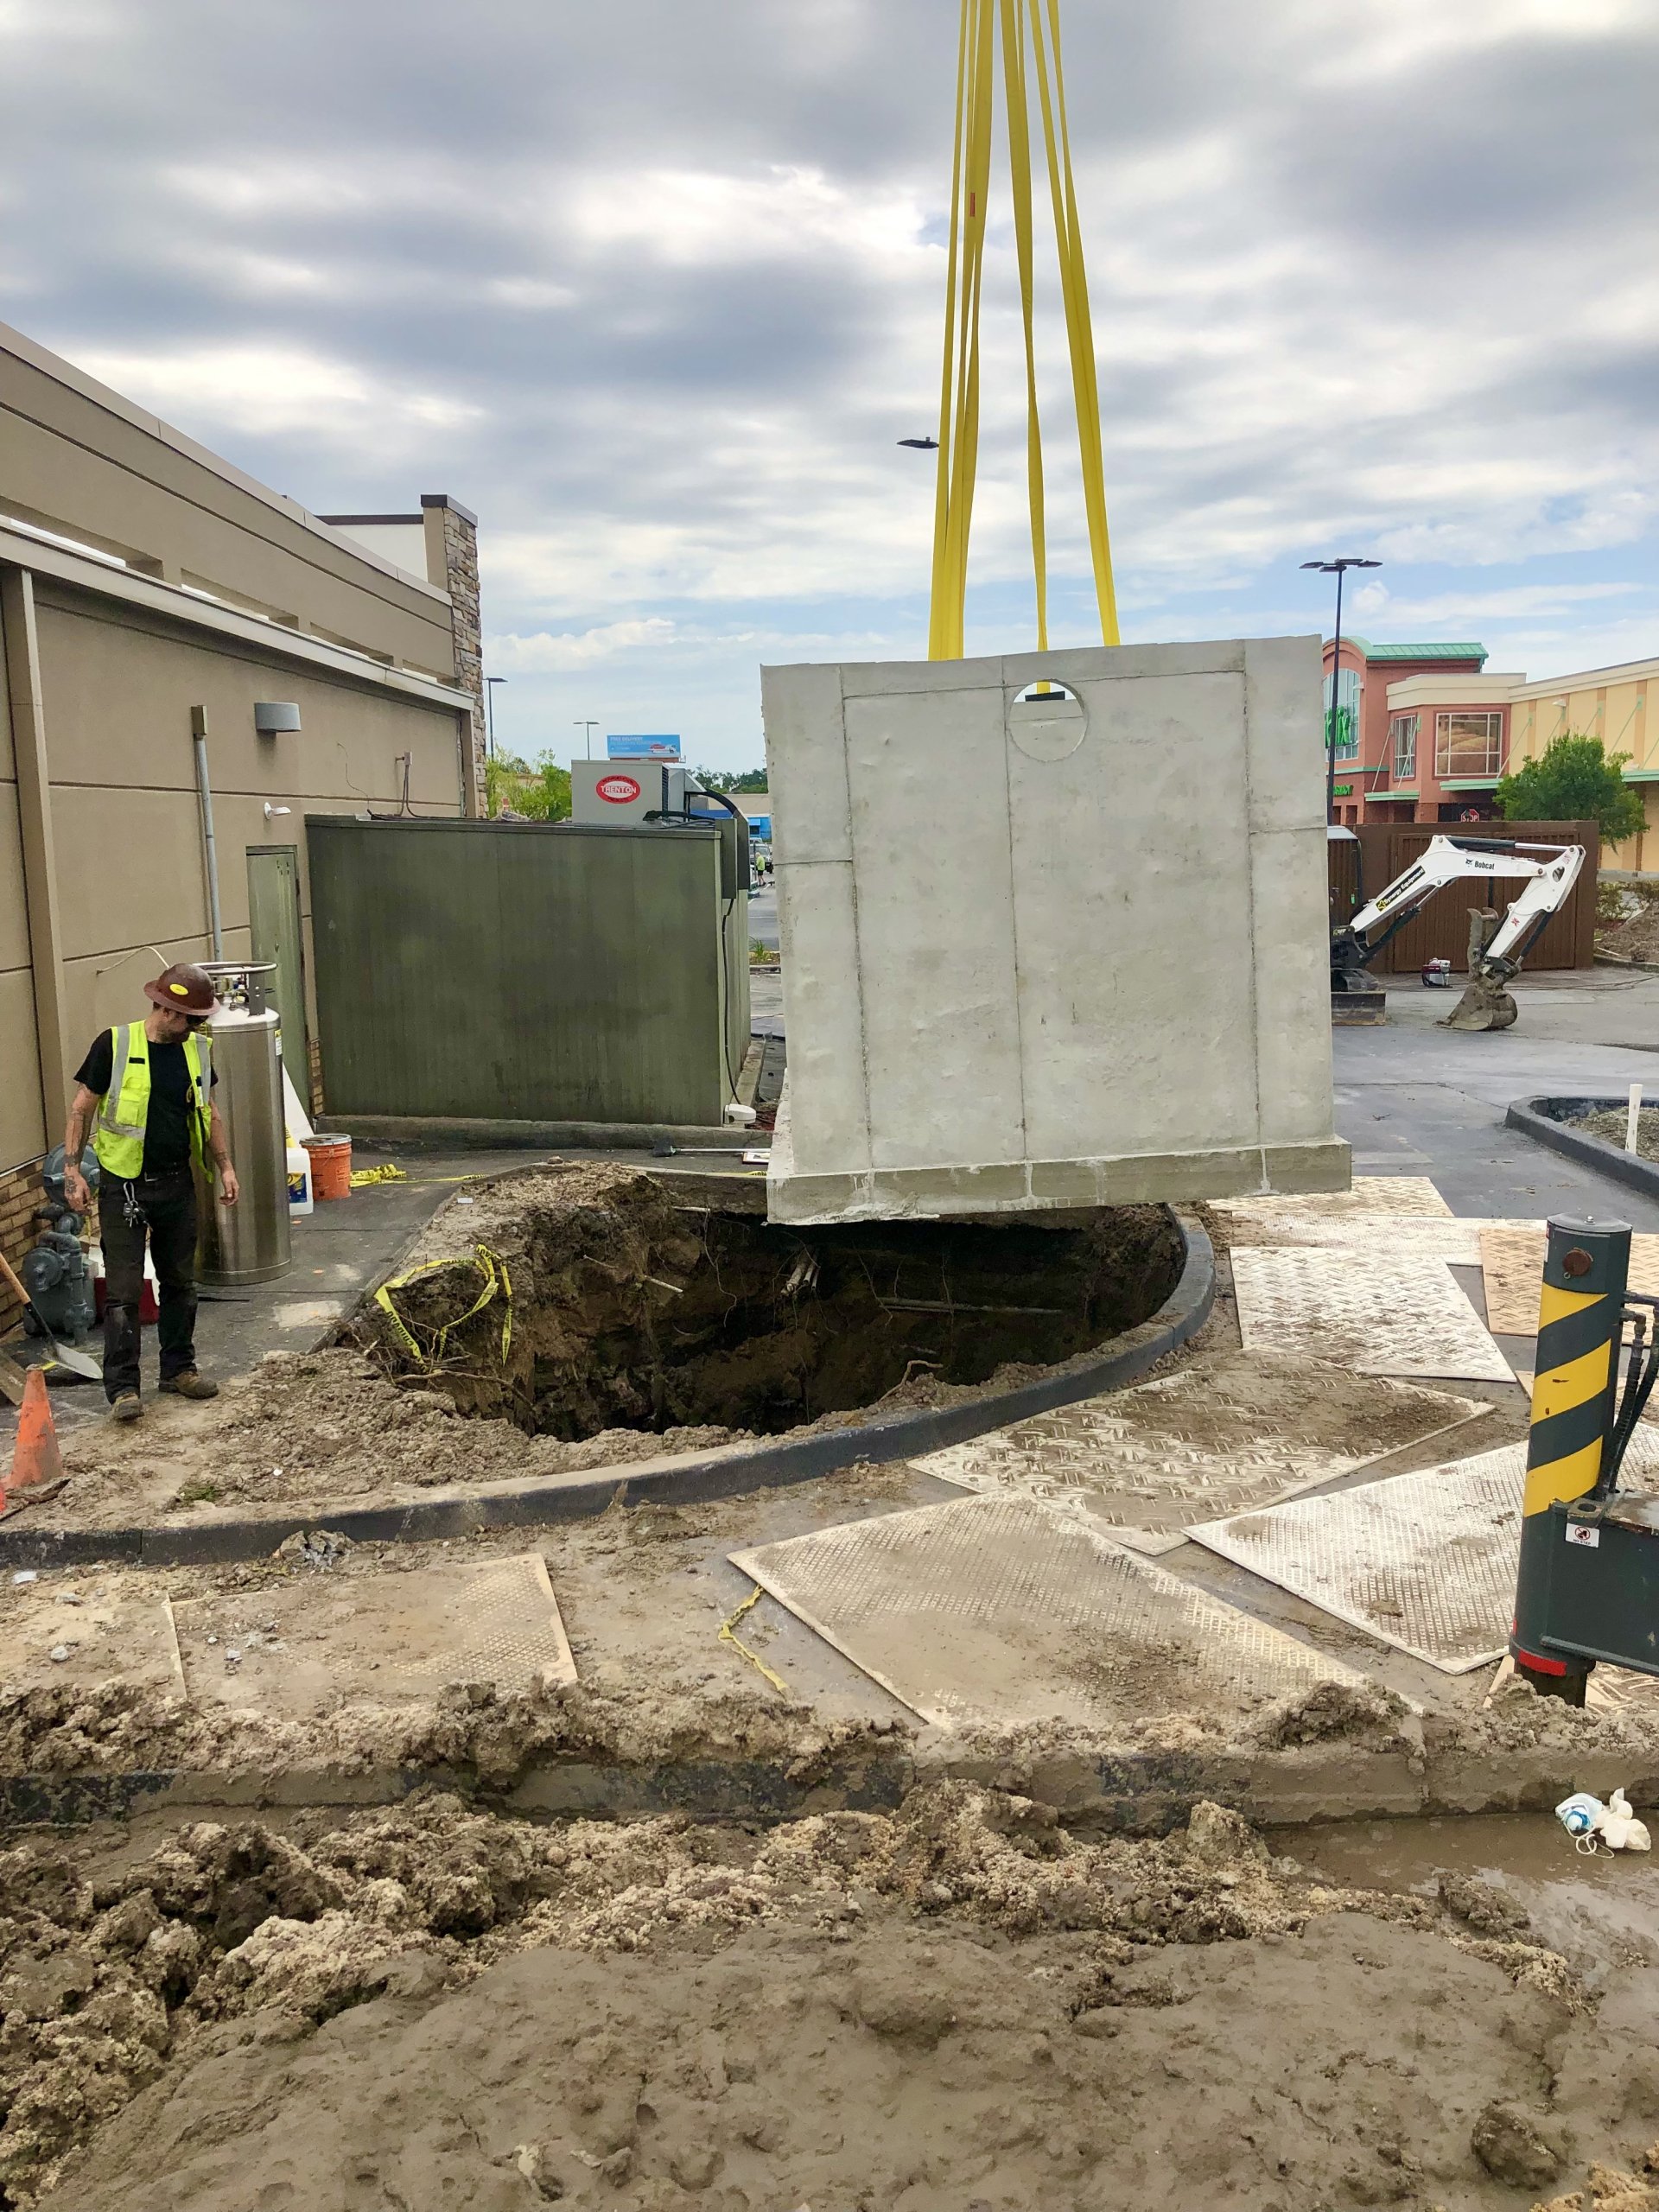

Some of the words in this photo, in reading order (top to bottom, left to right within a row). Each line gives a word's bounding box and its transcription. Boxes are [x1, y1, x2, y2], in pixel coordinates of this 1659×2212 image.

[601, 785, 637, 794] TRENTON
[1475, 861, 1495, 869] Bobcat
[1384, 888, 1402, 904] Synergy
[1401, 868, 1424, 889] Equipment
